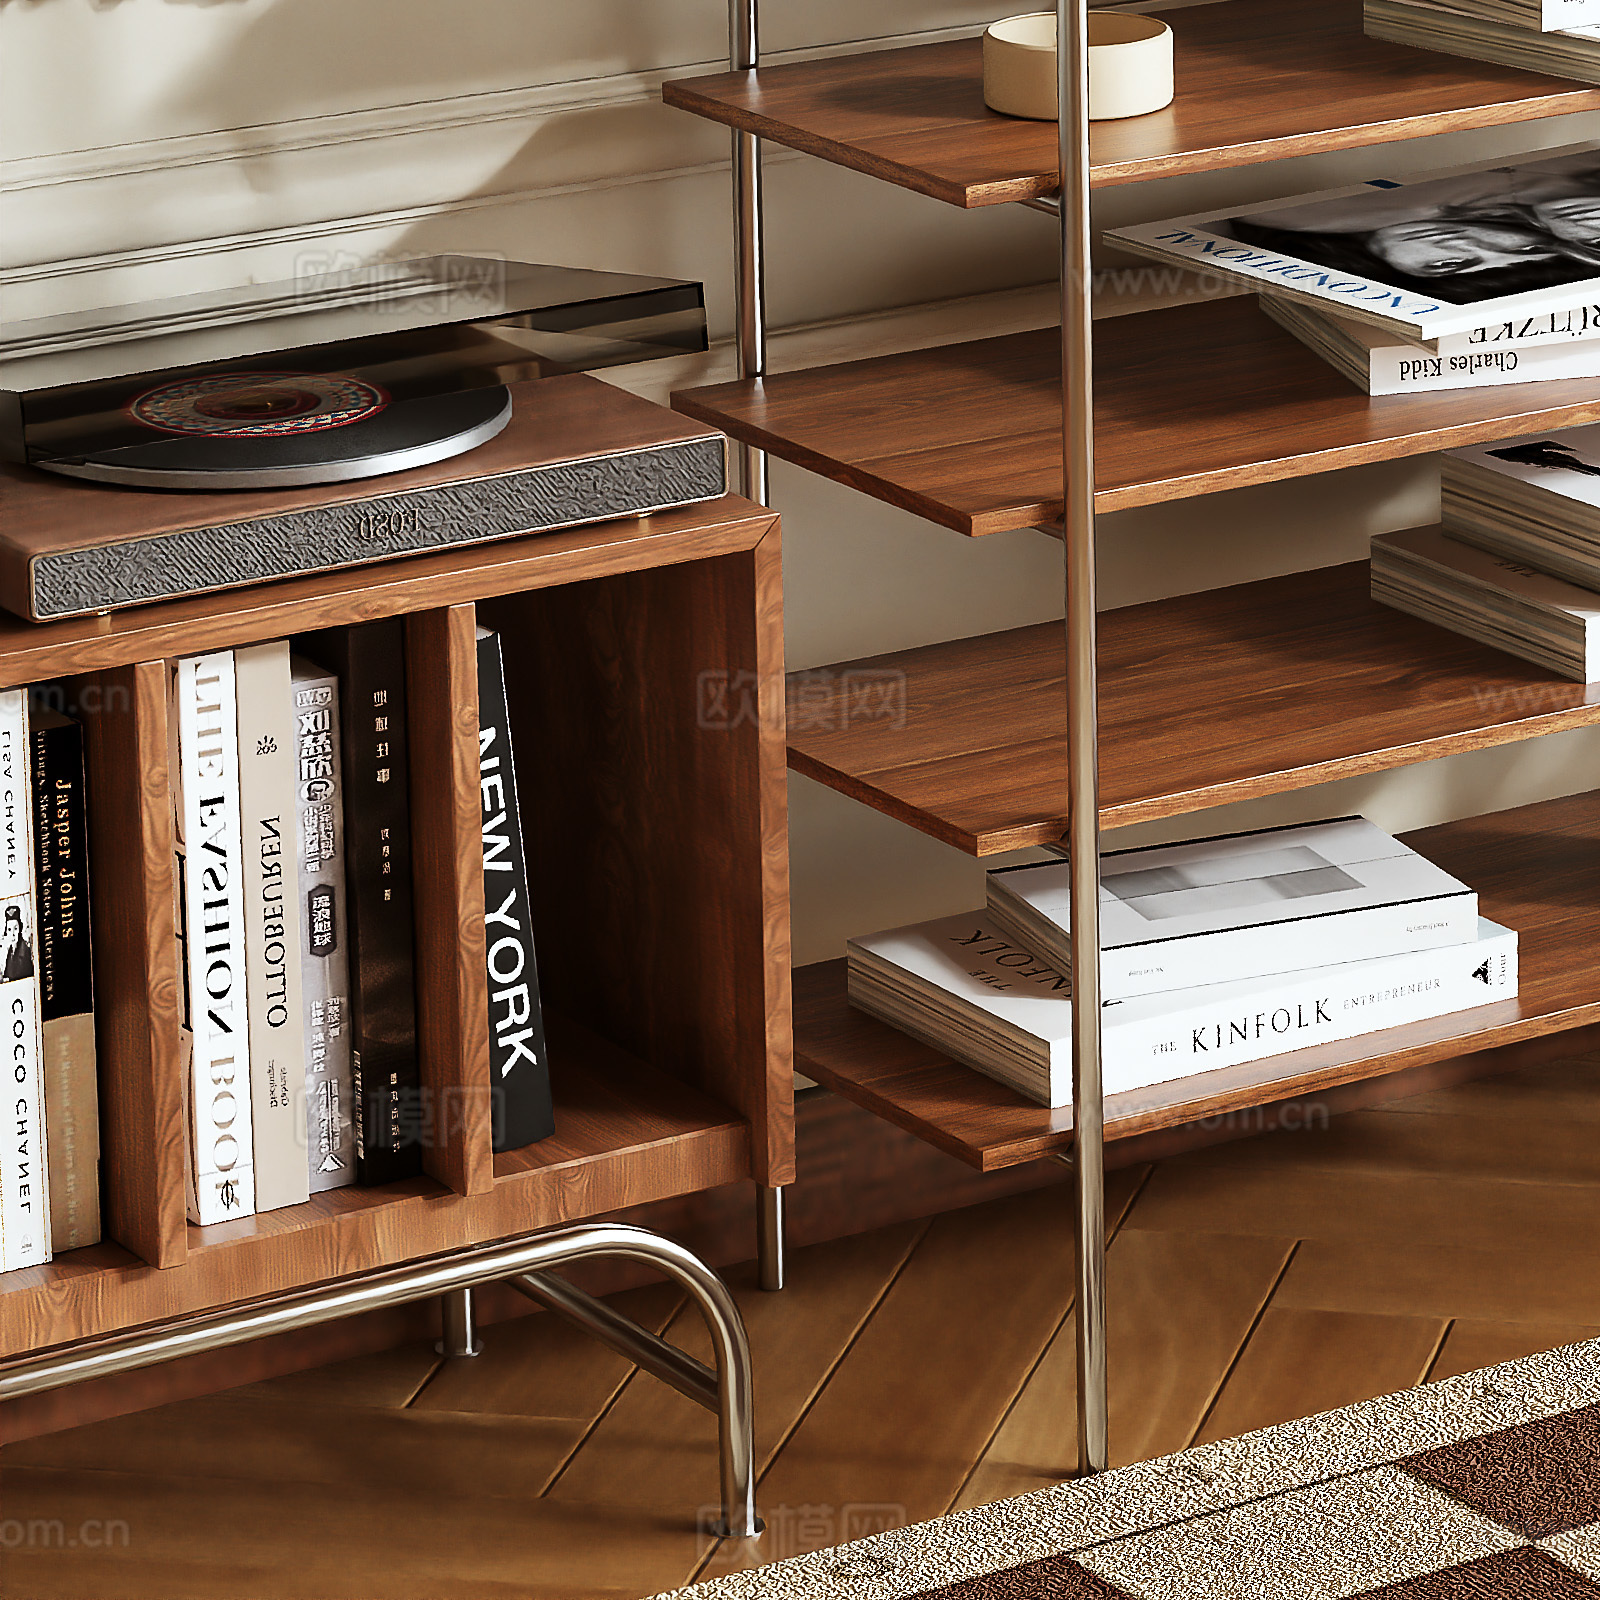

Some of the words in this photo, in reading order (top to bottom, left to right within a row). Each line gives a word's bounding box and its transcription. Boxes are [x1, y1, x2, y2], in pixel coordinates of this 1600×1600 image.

[1155, 228, 1441, 316] UNCONDITIONAL
[1399, 356, 1442, 380] Kidd
[1450, 352, 1518, 372] Charles
[53, 778, 72, 857] Jasper
[479, 726, 514, 871] NEW
[59, 867, 76, 940] Johns
[485, 887, 538, 1079] YORK
[969, 969, 1014, 991] THE
[1192, 997, 1332, 1054] KINFOLK
[1343, 978, 1441, 1011] ENTREPRENEUR
